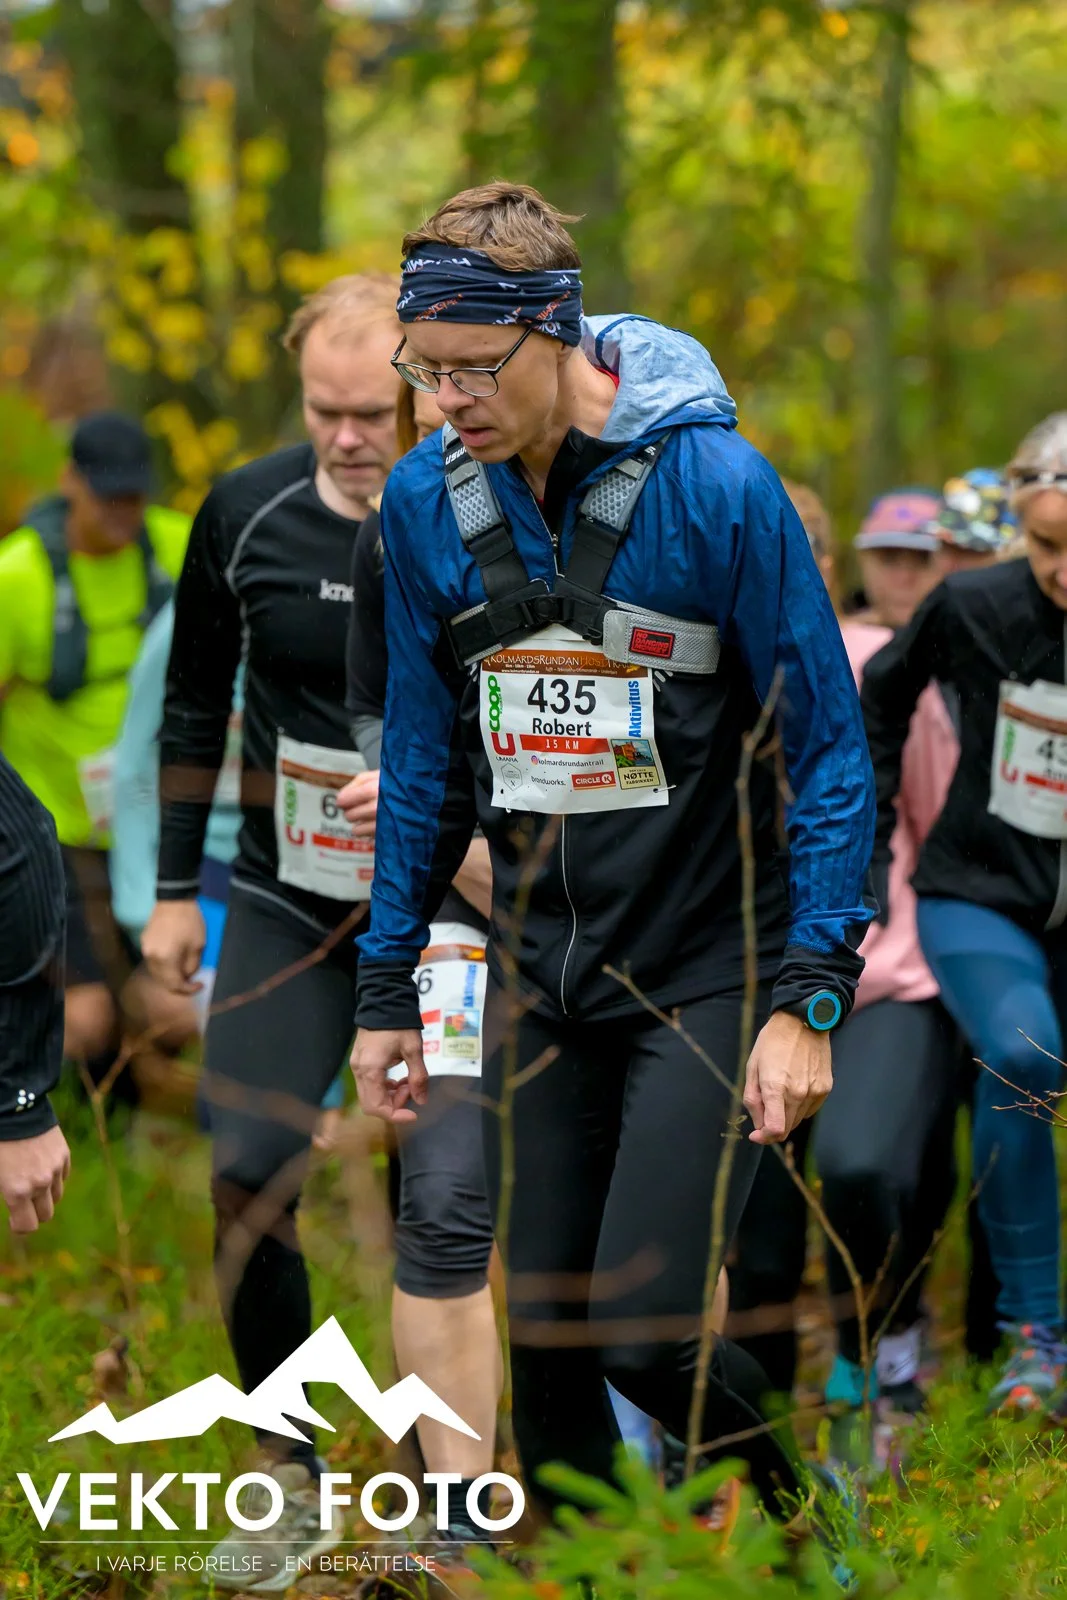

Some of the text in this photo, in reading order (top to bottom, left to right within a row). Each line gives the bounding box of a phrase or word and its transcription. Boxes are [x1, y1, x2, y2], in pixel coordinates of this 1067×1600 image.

[527, 677, 597, 716] 435
[627, 680, 642, 738] Aktivitus
[532, 717, 593, 737] Robert
[545, 739, 580, 750] 15 KM
[575, 776, 601, 785] CIRCLE
[623, 771, 655, 781] NØTTE
